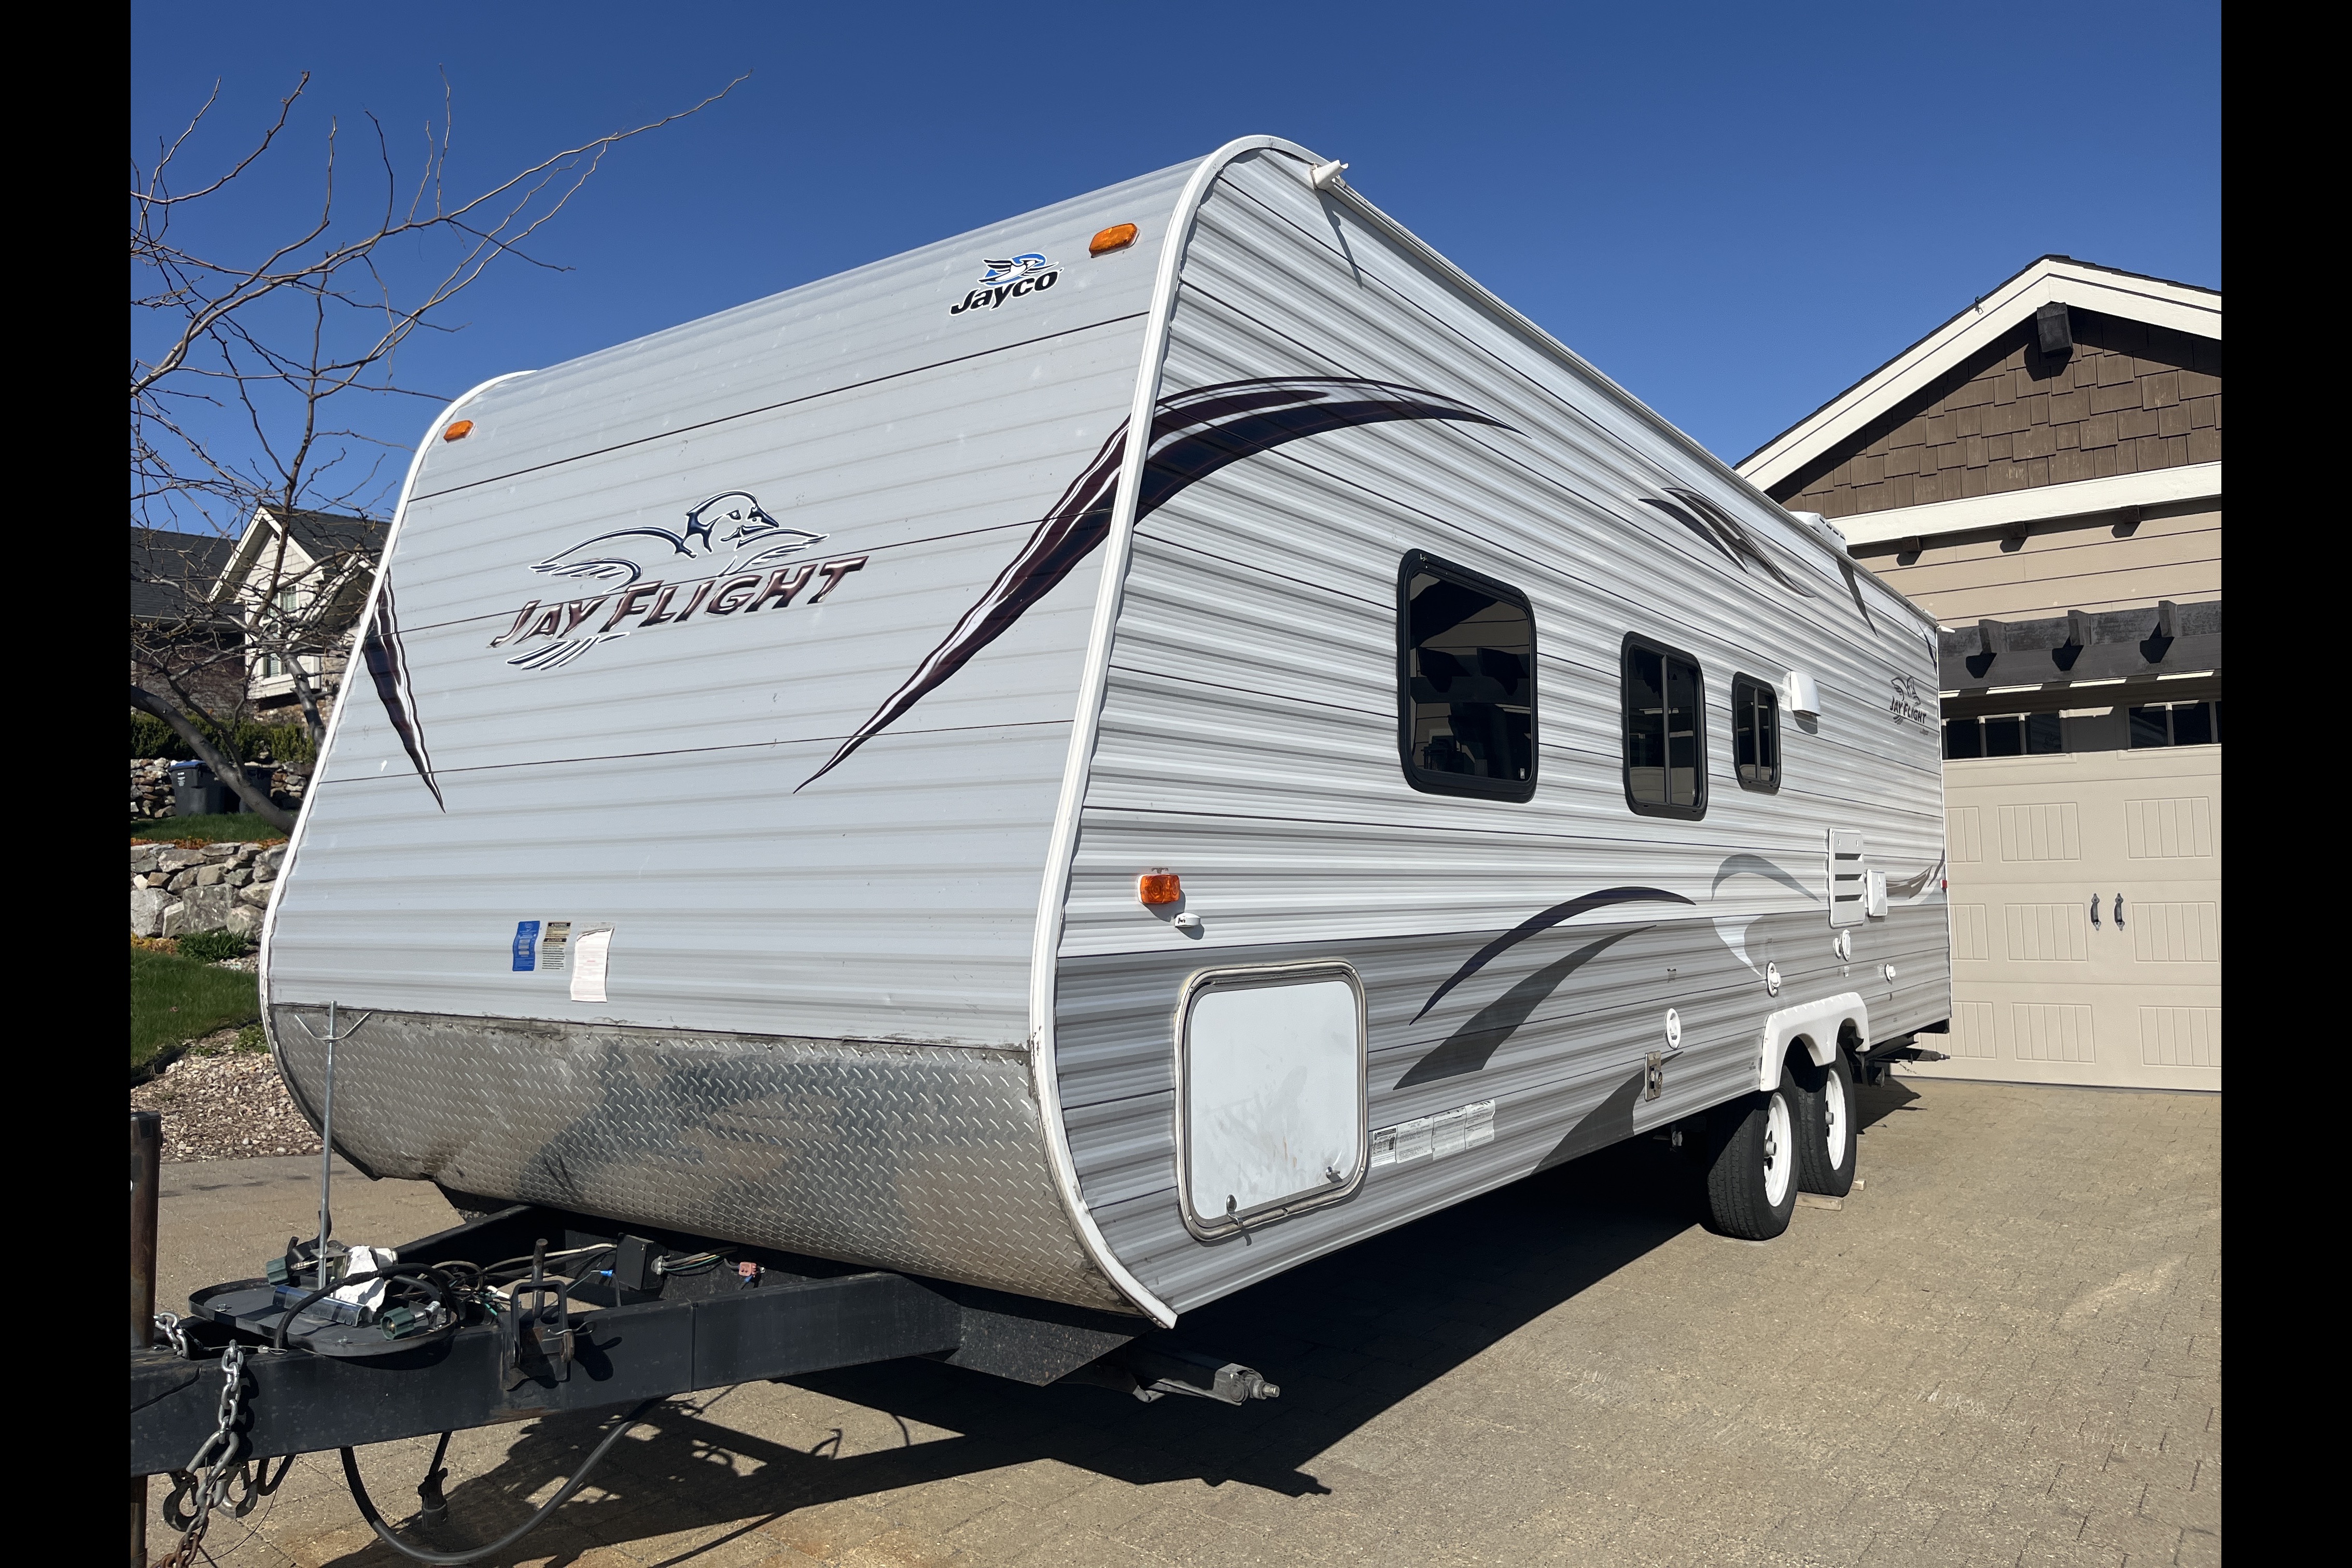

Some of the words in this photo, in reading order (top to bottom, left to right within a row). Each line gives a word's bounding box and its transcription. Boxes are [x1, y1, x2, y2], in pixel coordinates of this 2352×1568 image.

[950, 270, 1059, 315] Jayco
[487, 596, 610, 648] JAY
[598, 555, 870, 633] FLIGHT
[1889, 695, 1903, 714] JAY
[1903, 701, 1927, 724] FLIGHT
